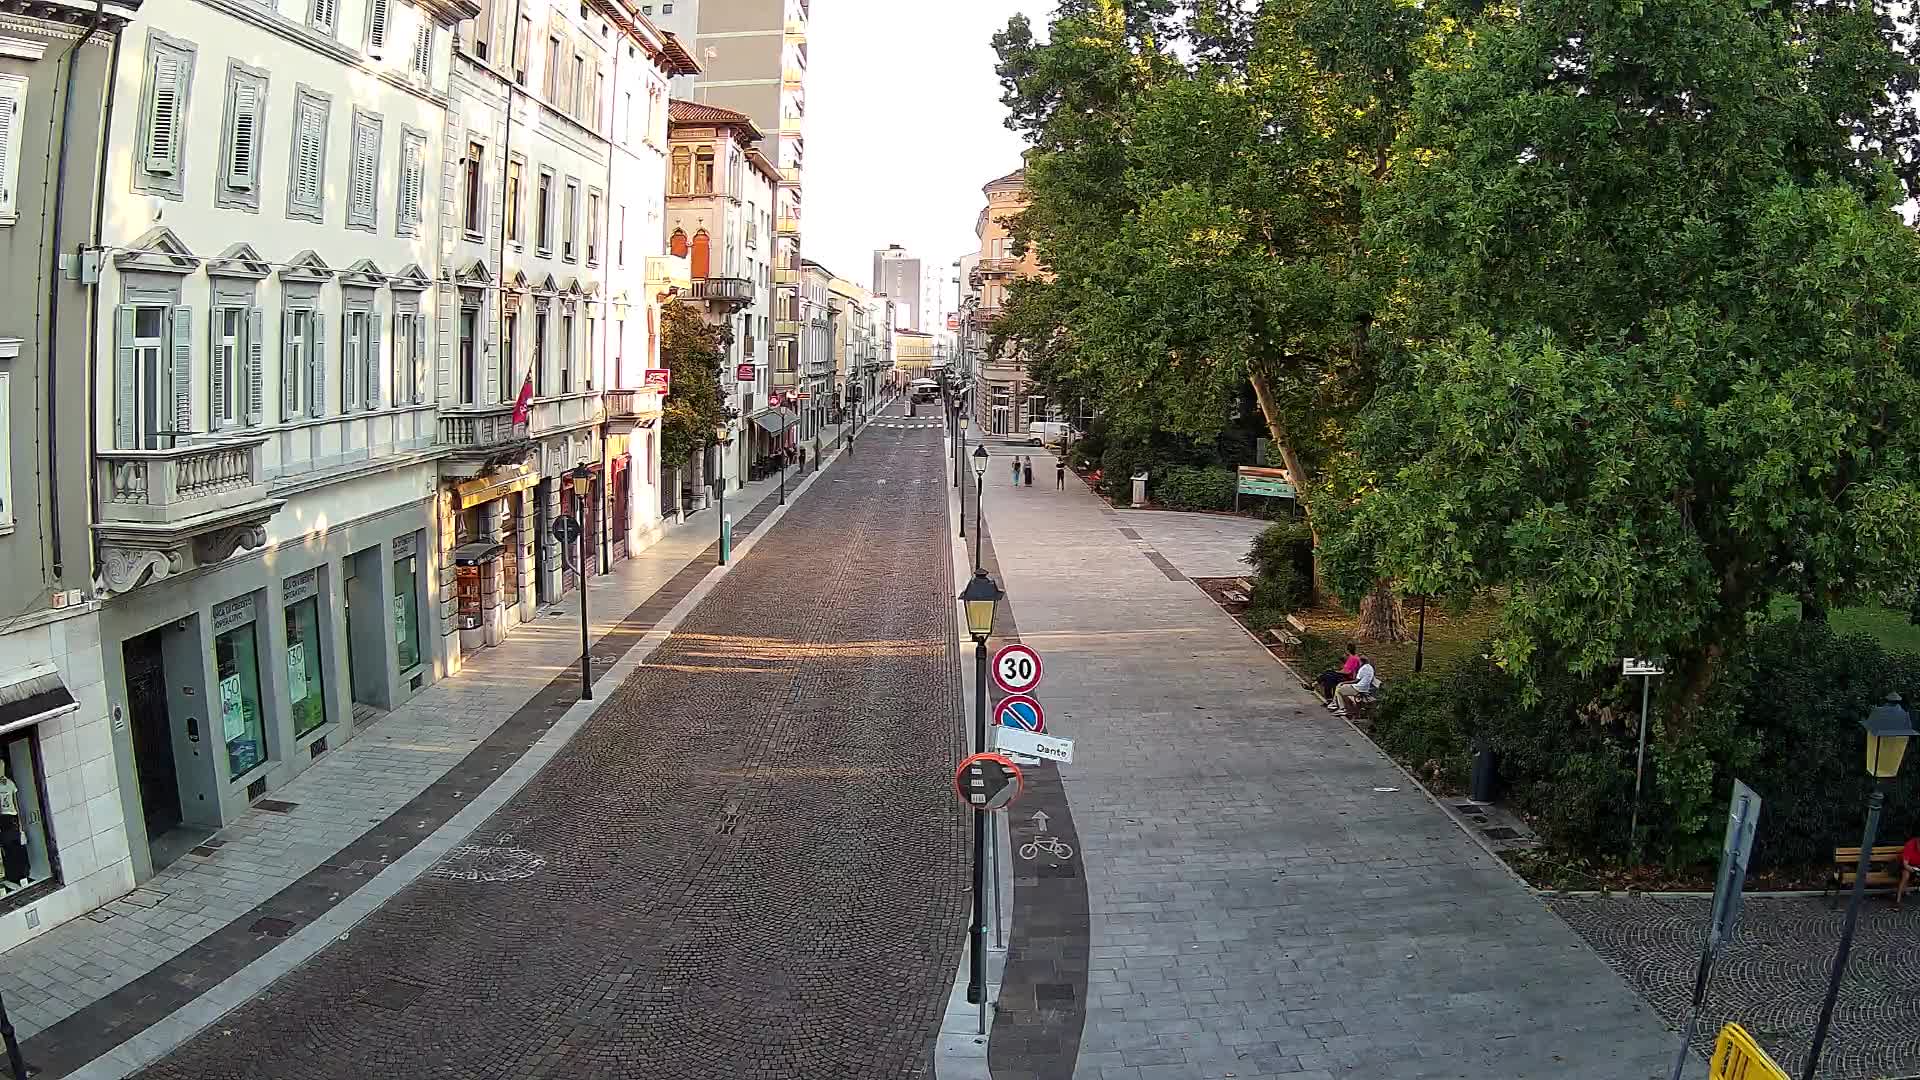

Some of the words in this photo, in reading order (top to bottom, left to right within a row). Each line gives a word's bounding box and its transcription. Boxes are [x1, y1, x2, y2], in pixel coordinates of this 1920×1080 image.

[288, 645, 303, 666] 130
[1004, 658, 1031, 679] 30
[220, 678, 239, 699] 130
[1036, 743, 1067, 758] Dante
